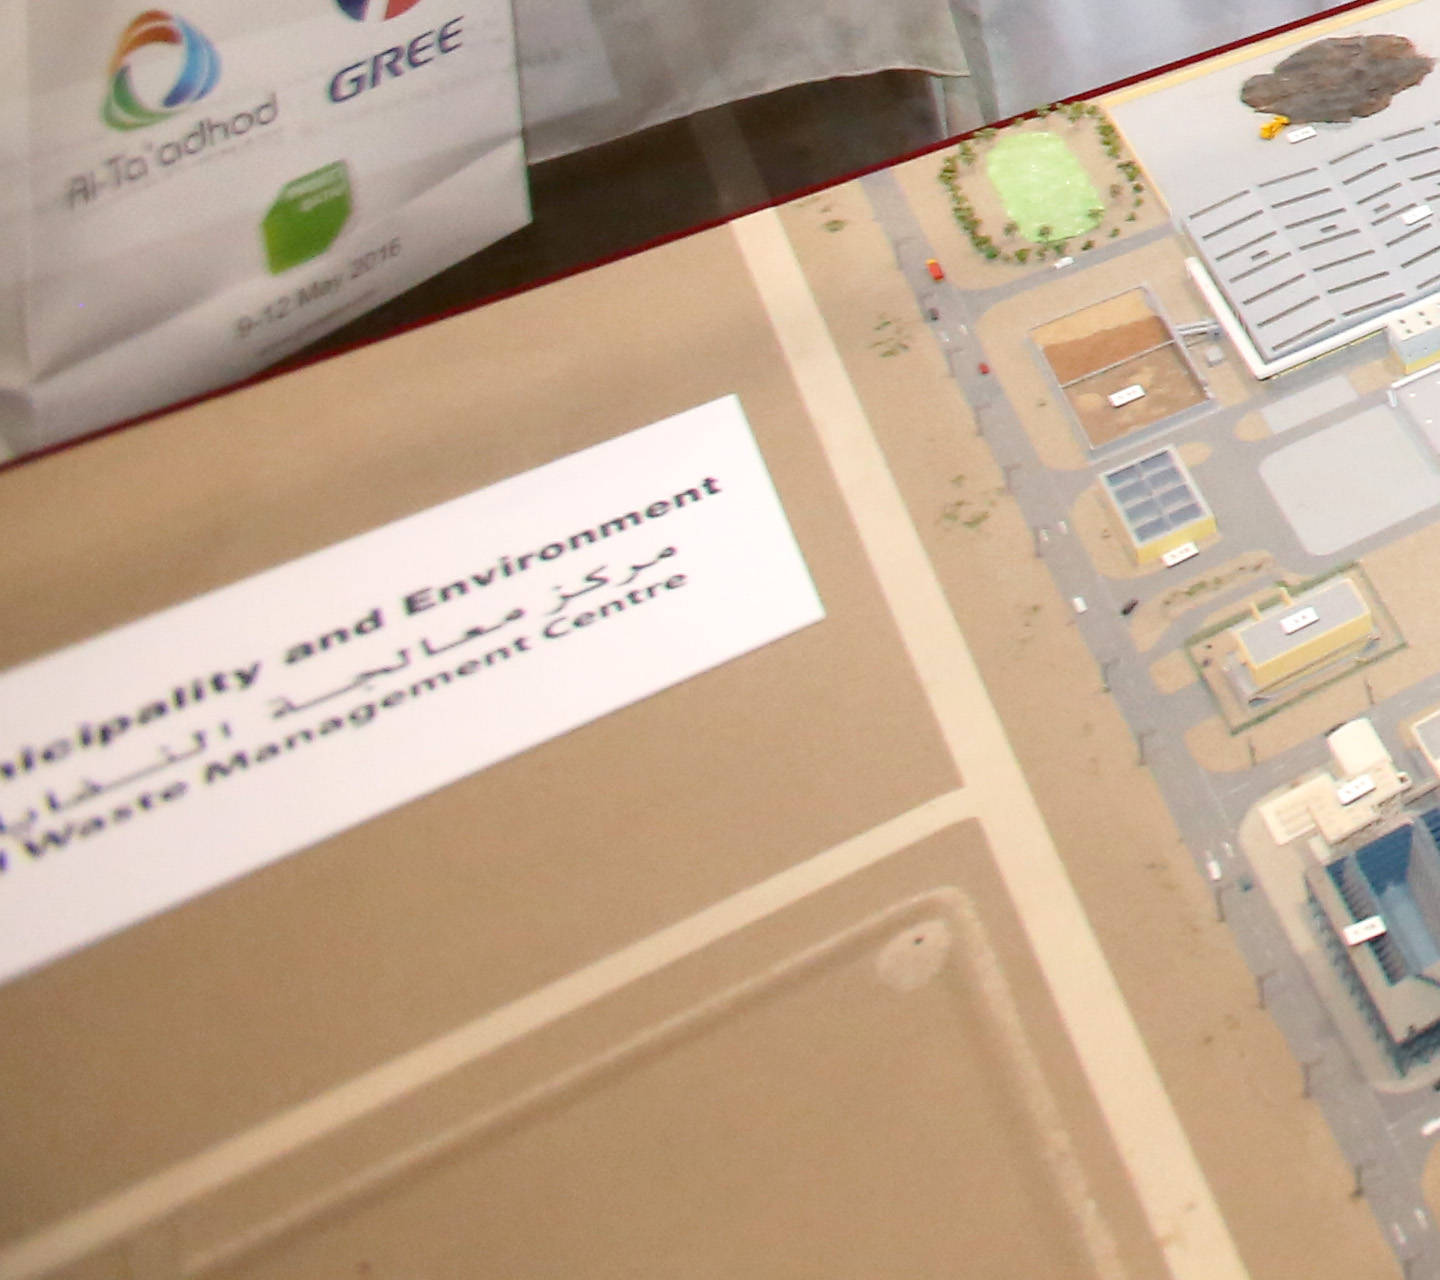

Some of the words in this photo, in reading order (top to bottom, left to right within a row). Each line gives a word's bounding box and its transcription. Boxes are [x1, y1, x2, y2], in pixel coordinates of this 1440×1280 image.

[328, 15, 465, 104] GREE
[283, 608, 386, 668] and
[402, 475, 723, 618] Environment
[545, 544, 678, 616] مركز
[22, 777, 190, 863] Waste
[202, 633, 533, 785] Management
[541, 571, 689, 640] Centre
